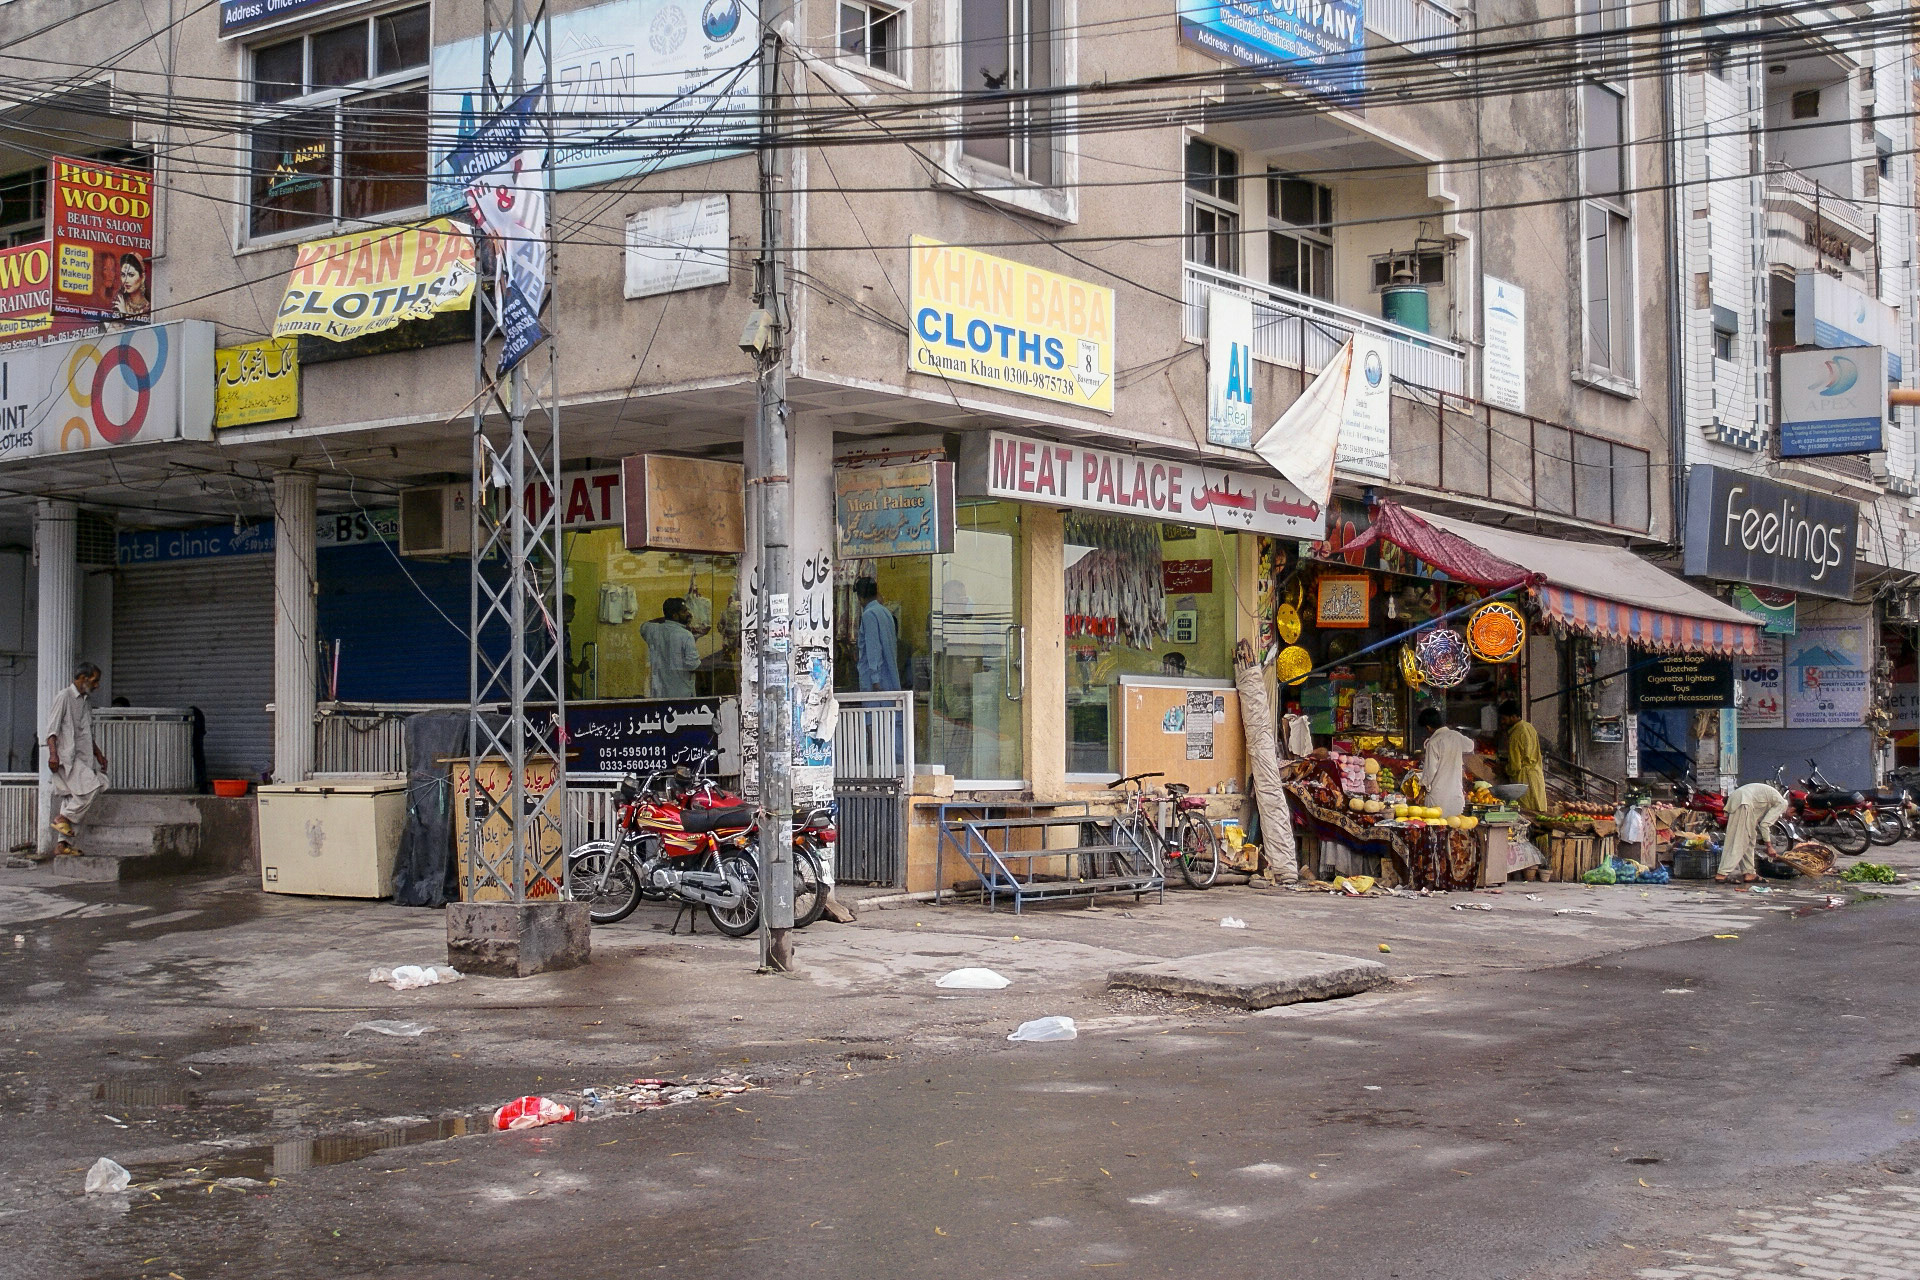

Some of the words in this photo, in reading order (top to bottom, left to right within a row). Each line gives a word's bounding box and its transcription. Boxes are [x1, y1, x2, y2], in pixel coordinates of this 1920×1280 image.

[225, 3, 263, 24] Address:
[1263, 10, 1292, 33] General
[1294, 24, 1315, 43] Order
[1198, 30, 1230, 53] Address:
[1233, 46, 1254, 64] Office
[60, 163, 152, 196] HOLLY
[61, 187, 150, 219] WOOD
[67, 212, 104, 230] BEAUTY
[106, 218, 143, 234] SALOON
[57, 225, 65, 237] &
[67, 227, 114, 245] TRAINING
[115, 234, 152, 250] CENTER
[65, 247, 89, 258] Bridal
[290, 232, 404, 287] KHAN
[61, 258, 68, 266] &
[70, 259, 91, 271] Party
[61, 269, 92, 281] Makeup
[62, 279, 89, 291] Expert
[449, 270, 462, 287] 8
[916, 241, 1015, 320] KHAN
[1024, 270, 1109, 343] BABA
[20, 315, 47, 329] Expert
[55, 305, 80, 315] Madani
[80, 307, 99, 317] Tower
[101, 310, 111, 319] Ph:
[276, 320, 322, 334] haman
[917, 307, 1065, 371] CLOTHS
[918, 347, 967, 373] Chaman
[971, 358, 1000, 380] Khan
[1003, 366, 1075, 396] 0300-9875738
[1085, 354, 1092, 373] 8
[0, 404, 28, 431] INT
[1228, 405, 1248, 426] Real
[992, 437, 1074, 498] MEAT
[1083, 452, 1184, 514] PALACE
[505, 474, 620, 529] MEAT
[847, 498, 879, 512] Meat
[882, 493, 925, 511] Palace
[1190, 473, 1257, 525] پیلس
[1263, 483, 1321, 526] میٹ
[168, 530, 221, 557] clinic
[1724, 487, 1843, 580] Feelings
[1647, 675, 1683, 684] Cigarette
[1685, 674, 1715, 684] lighters
[1663, 665, 1698, 673] Watches
[1805, 666, 1865, 690] garrison
[1639, 694, 1676, 703] Computer
[1672, 684, 1690, 693] Toys
[627, 711, 662, 735] ٹیلرز
[663, 704, 714, 734] حسن
[599, 746, 667, 758] 051-5950181
[600, 759, 668, 771] 0333-5603443
